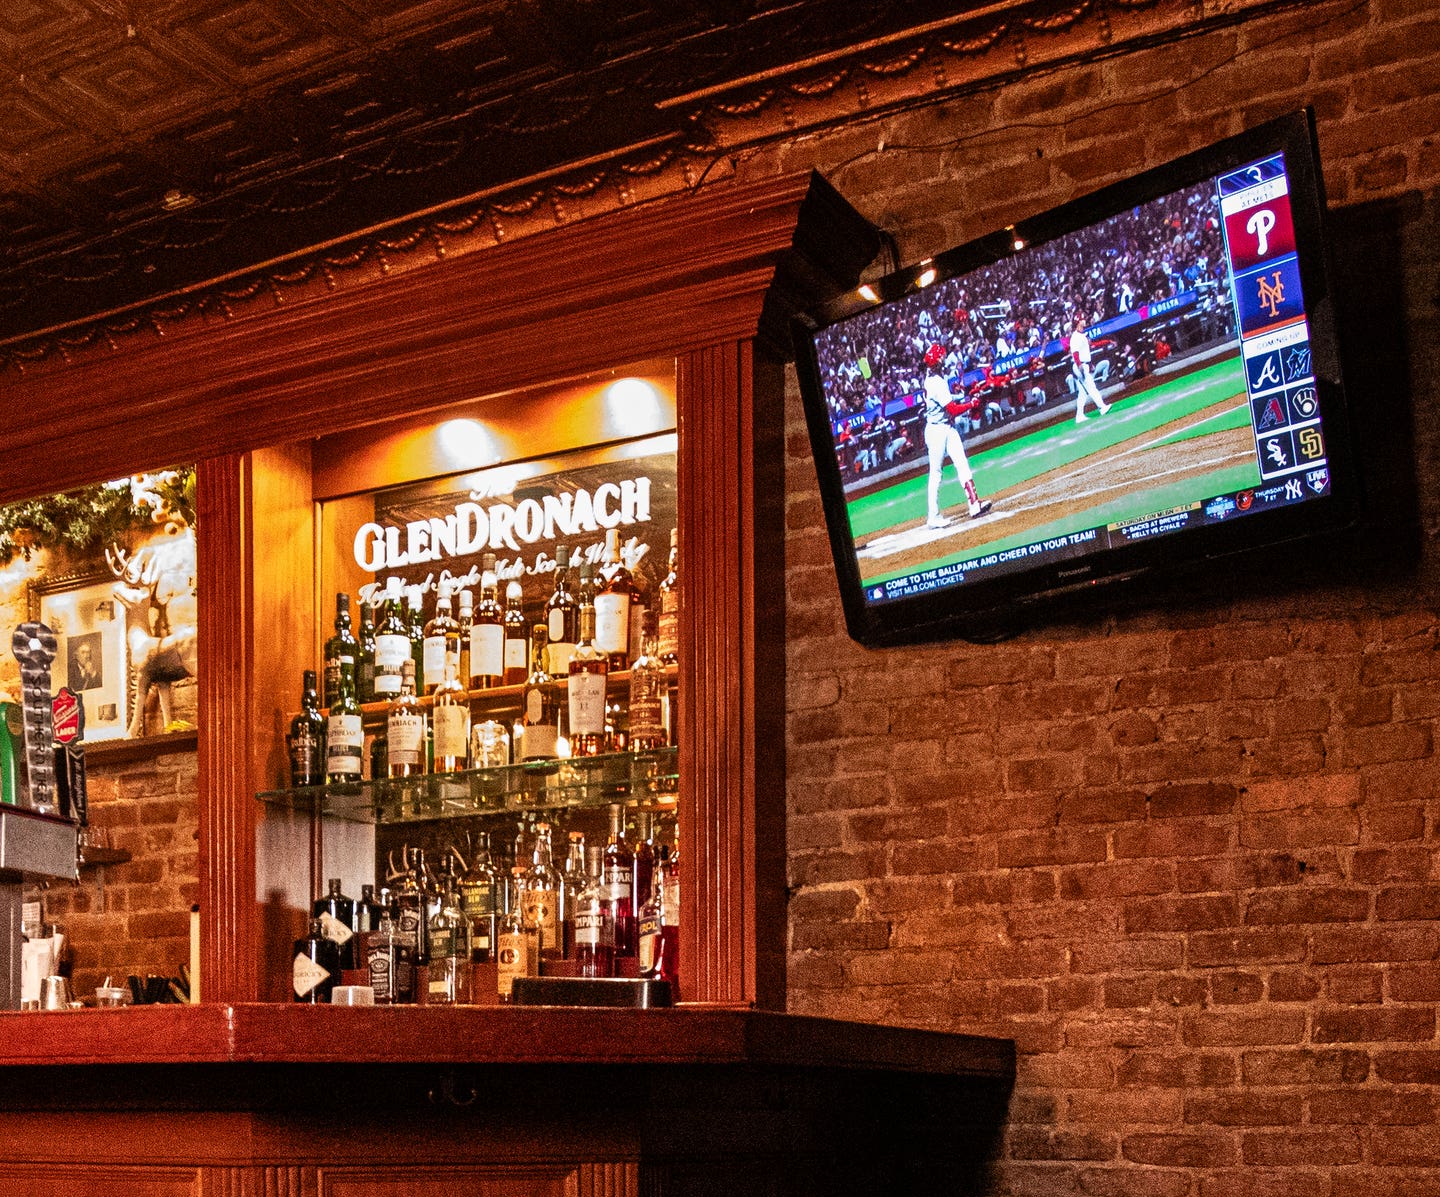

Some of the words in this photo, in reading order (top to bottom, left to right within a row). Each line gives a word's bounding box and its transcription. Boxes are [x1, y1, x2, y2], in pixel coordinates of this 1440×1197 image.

[1308, 470, 1326, 482] LIVE
[1255, 486, 1285, 498] THURSDAY
[886, 577, 909, 590] COME
[909, 575, 921, 584] TO
[921, 570, 937, 581] THE
[937, 560, 979, 575] BALLPARK
[980, 555, 998, 567] AND
[999, 548, 1028, 562] CHEER
[1029, 544, 1042, 555] ON
[1043, 537, 1068, 550] YOUR
[1068, 530, 1096, 545] TEAM!
[886, 588, 903, 599] VISIT
